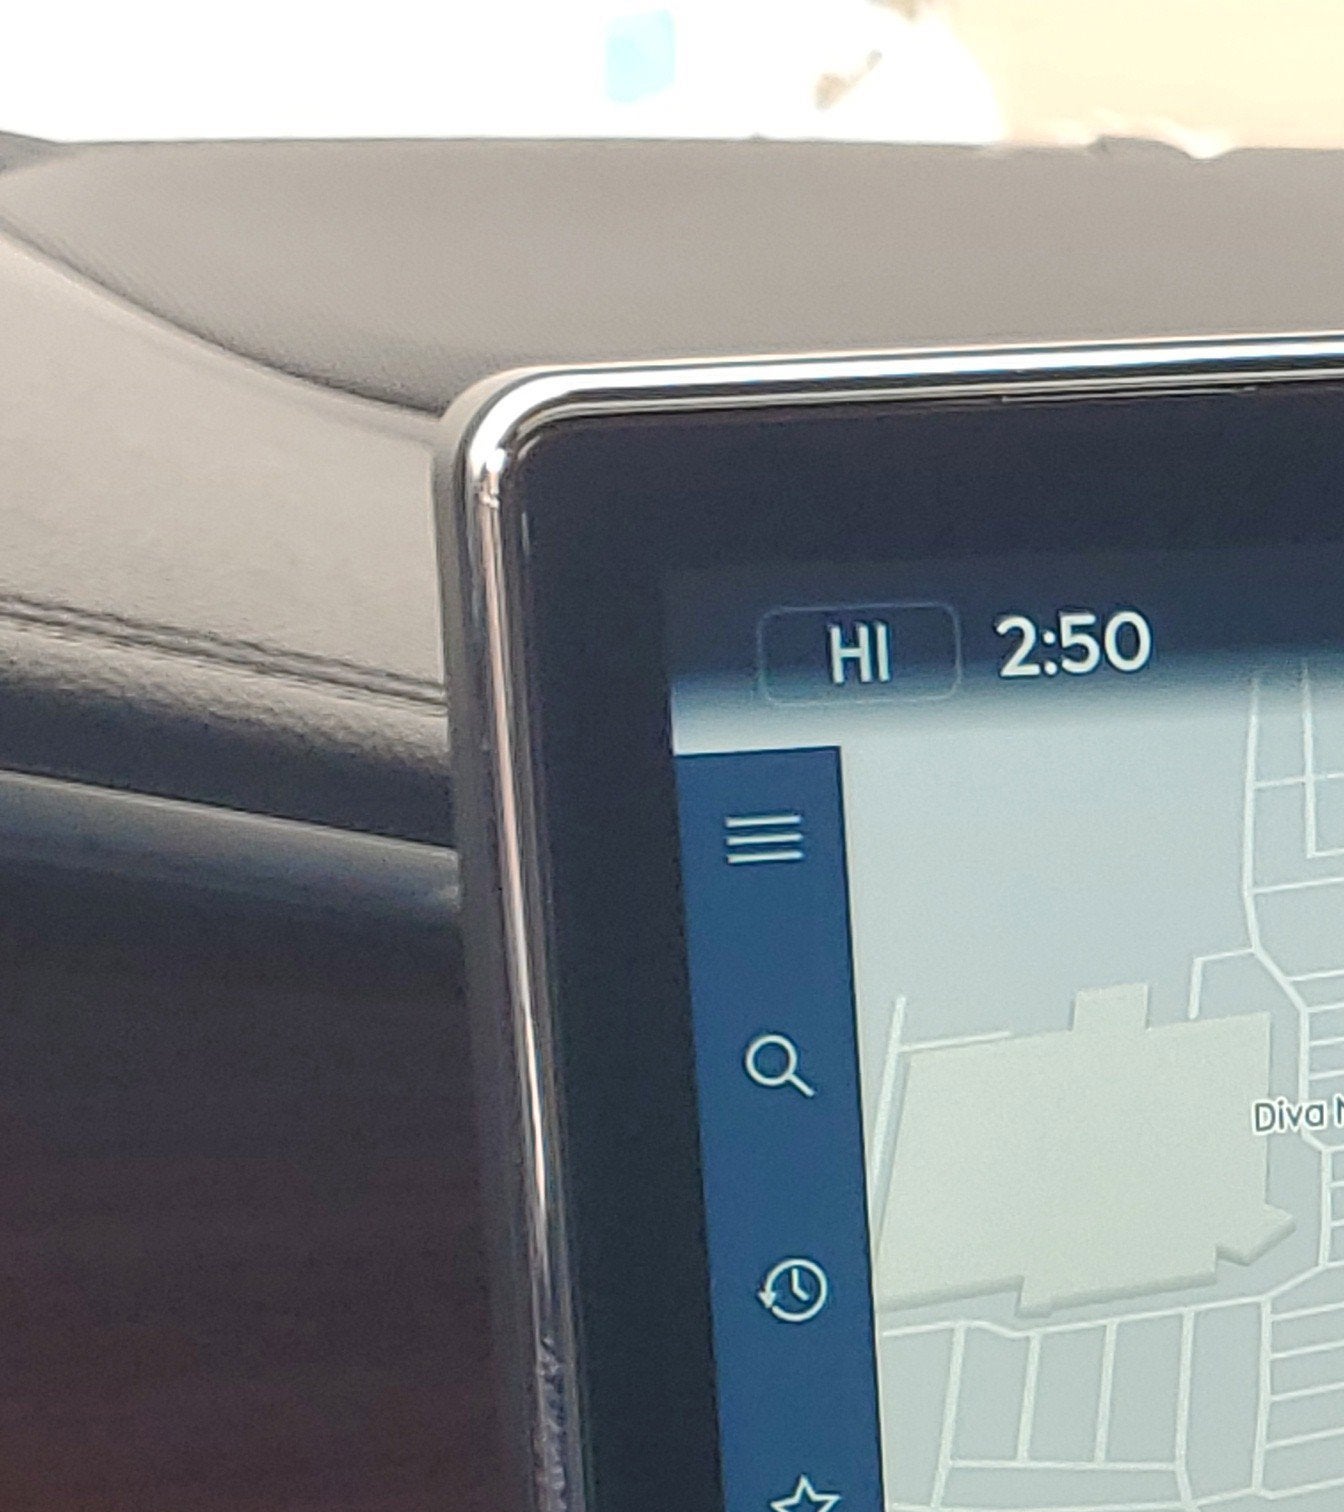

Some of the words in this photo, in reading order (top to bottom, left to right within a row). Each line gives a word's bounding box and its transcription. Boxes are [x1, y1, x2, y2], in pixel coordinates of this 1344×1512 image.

[831, 622, 890, 684] HI
[995, 610, 1152, 679] 2:50
[1254, 1096, 1325, 1136] Diva
